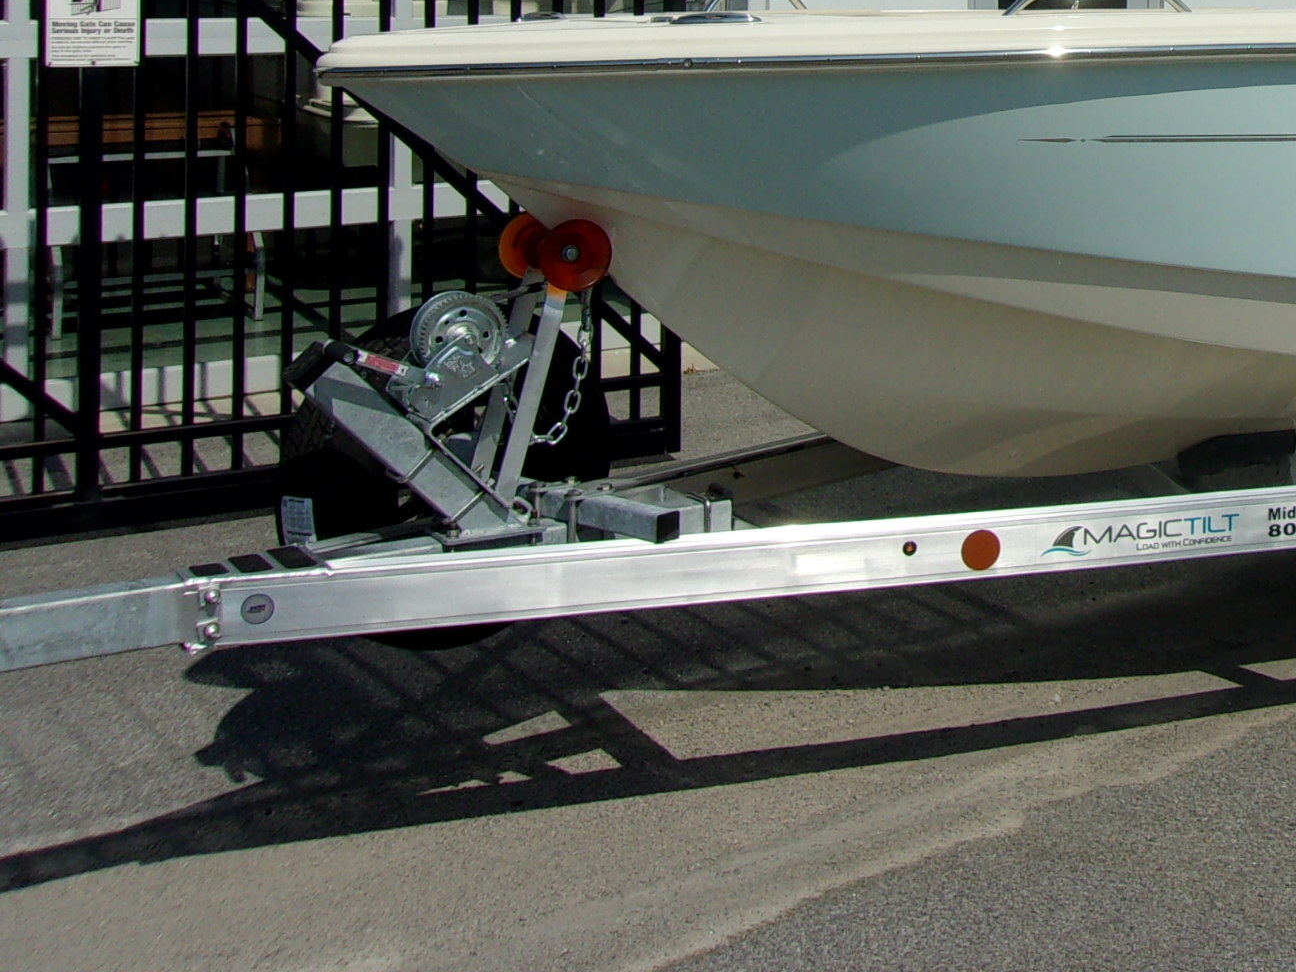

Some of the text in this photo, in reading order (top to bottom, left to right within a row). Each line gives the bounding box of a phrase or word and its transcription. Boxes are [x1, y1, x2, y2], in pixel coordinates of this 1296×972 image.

[1083, 513, 1240, 545] MAGICTILT
[1161, 541, 1182, 549] WITH
[1182, 535, 1233, 546] CONFIDENCE
